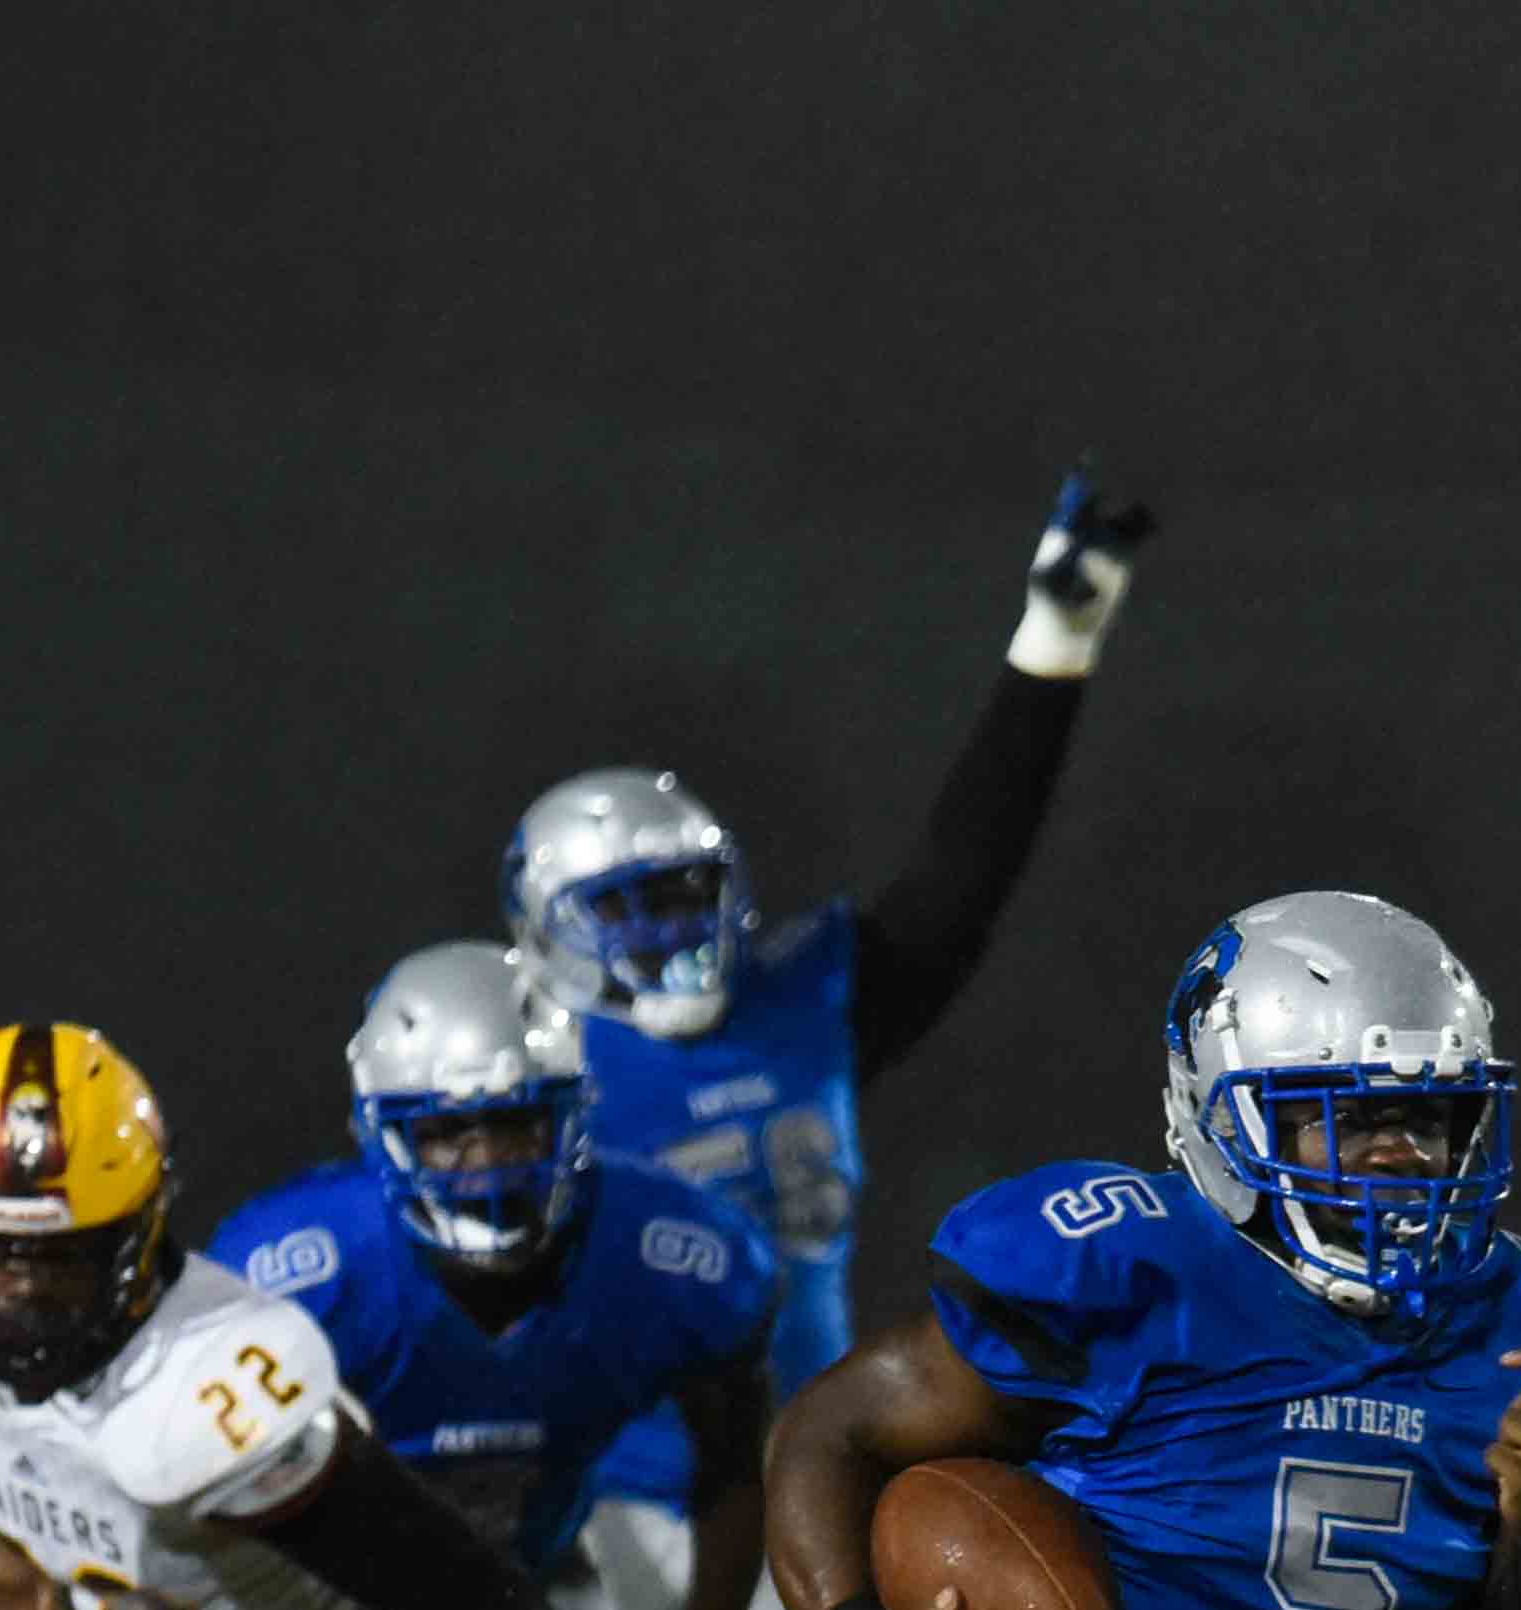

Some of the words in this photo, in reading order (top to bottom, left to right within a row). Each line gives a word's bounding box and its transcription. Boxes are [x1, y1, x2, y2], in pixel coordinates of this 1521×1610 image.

[1041, 1175, 1168, 1238] 5
[196, 1342, 306, 1452] 22
[1282, 1395, 1425, 1444] PANTHERS
